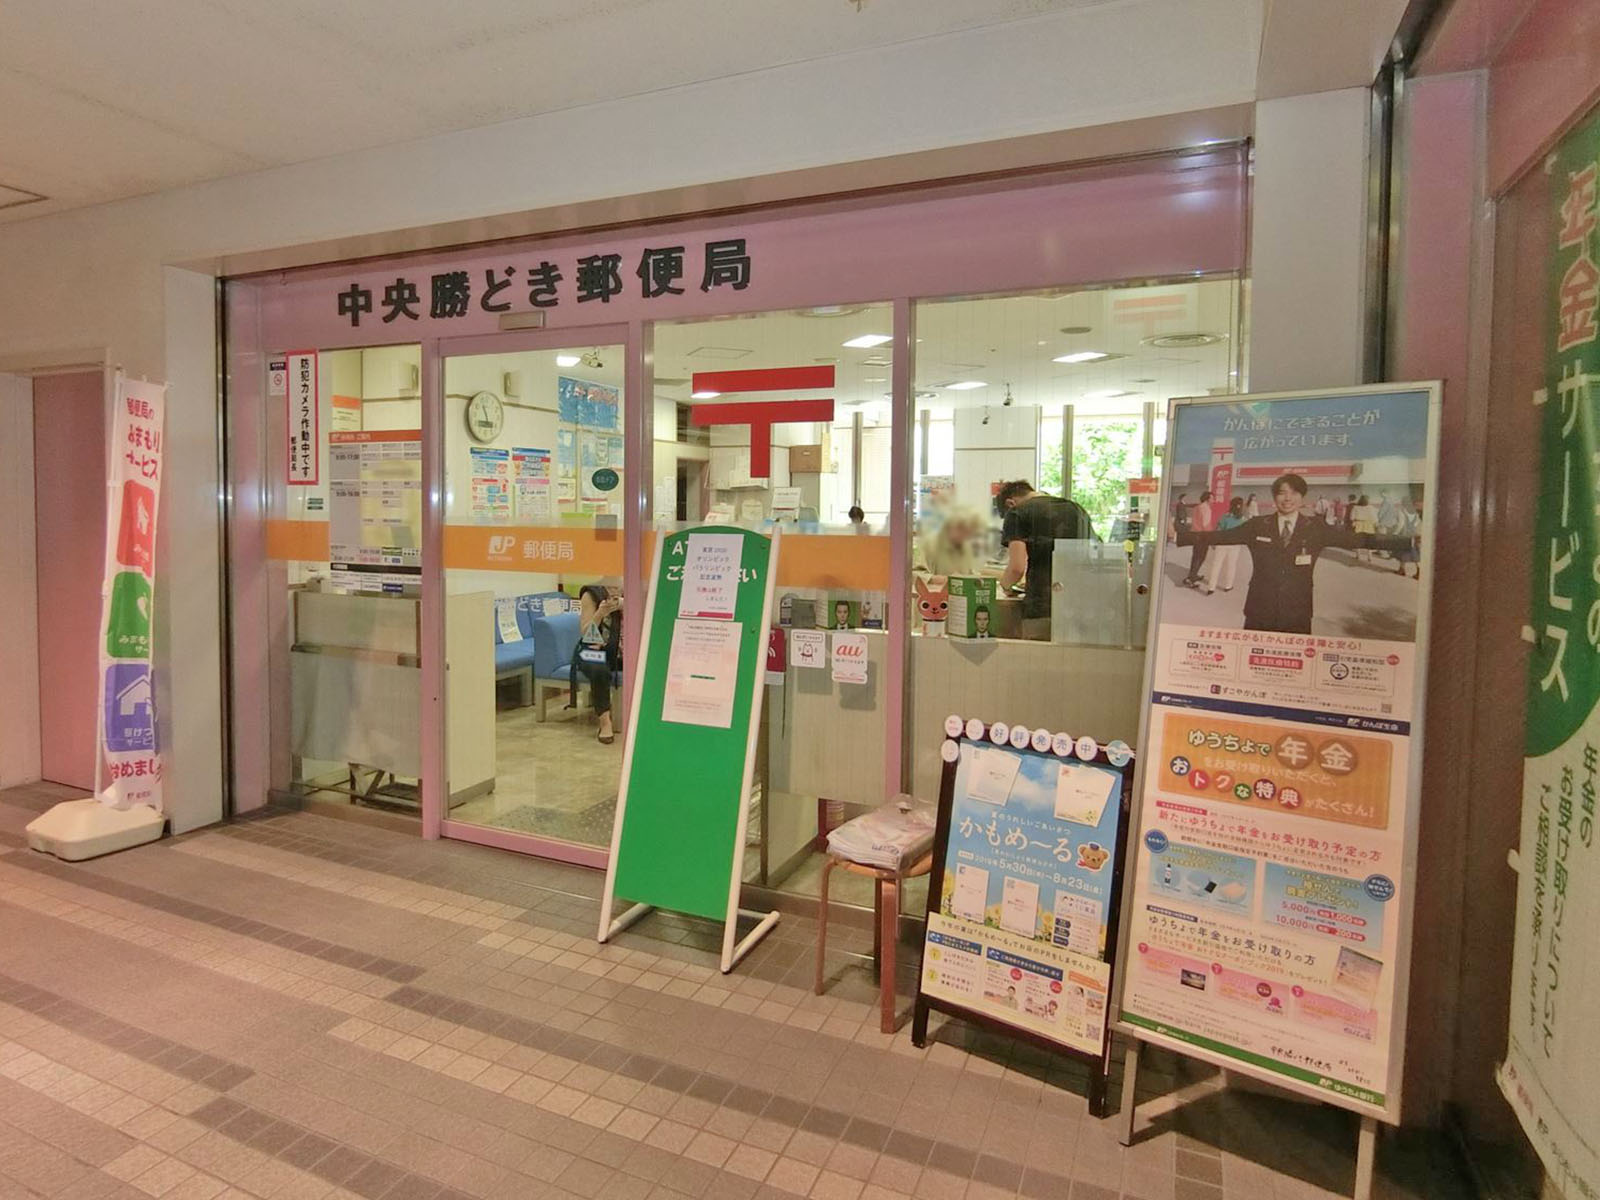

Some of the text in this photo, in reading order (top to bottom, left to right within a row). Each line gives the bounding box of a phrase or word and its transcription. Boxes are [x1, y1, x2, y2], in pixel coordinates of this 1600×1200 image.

[338, 239, 751, 327] 中央勝どき郵便局
[300, 358, 311, 478] 防犯カメラ作動中です
[1223, 409, 1381, 432] かんぽにできることが
[1243, 433, 1355, 450] 広がっています。
[523, 540, 575, 561] 郵便局
[836, 645, 863, 657] au
[994, 728, 1091, 754] 好評発売中
[1159, 810, 1383, 862] 新たにゆうちょで年金をお受け取り予定の方
[1149, 915, 1316, 966] ゆうちょで年金をお受け取りの方
